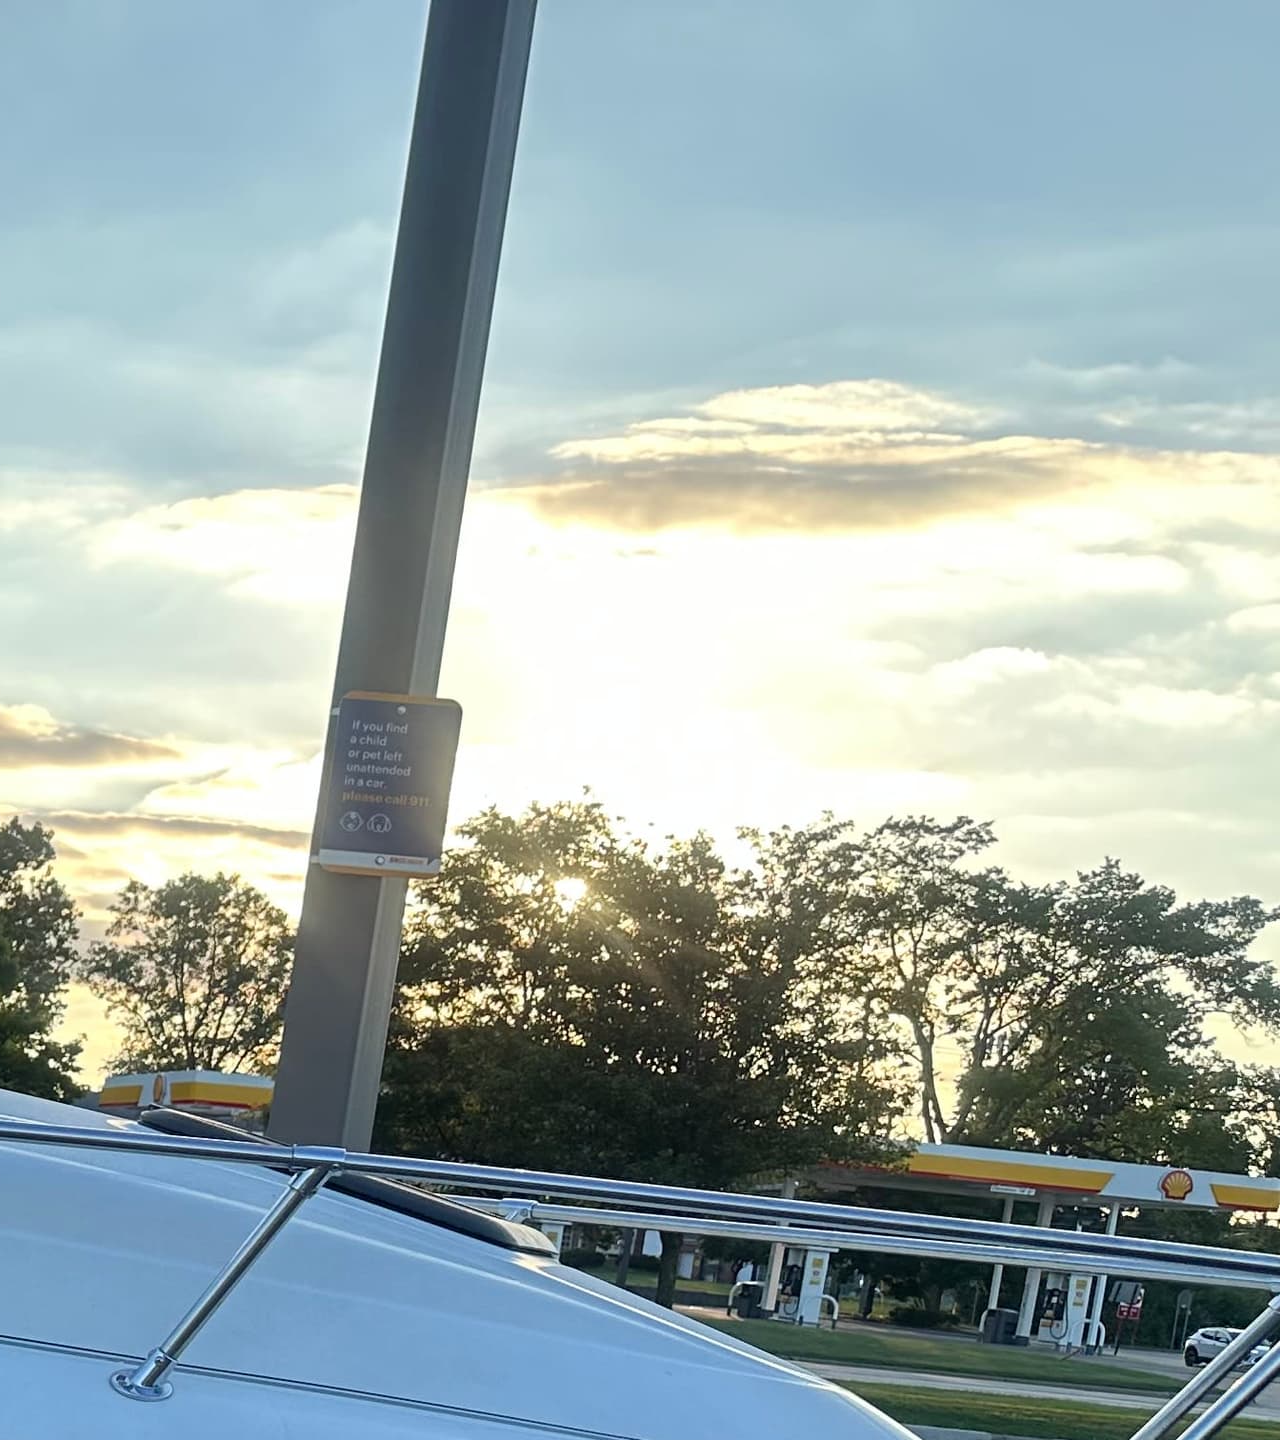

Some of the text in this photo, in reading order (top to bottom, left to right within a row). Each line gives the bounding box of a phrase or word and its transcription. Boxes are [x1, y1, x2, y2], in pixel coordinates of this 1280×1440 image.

[352, 719, 408, 734] If you find
[350, 735, 388, 746] a child
[348, 750, 403, 762] or pet left
[346, 763, 412, 777] unattended
[344, 775, 355, 786] in
[356, 779, 364, 787] a
[342, 791, 383, 803] please
[384, 794, 407, 805] call
